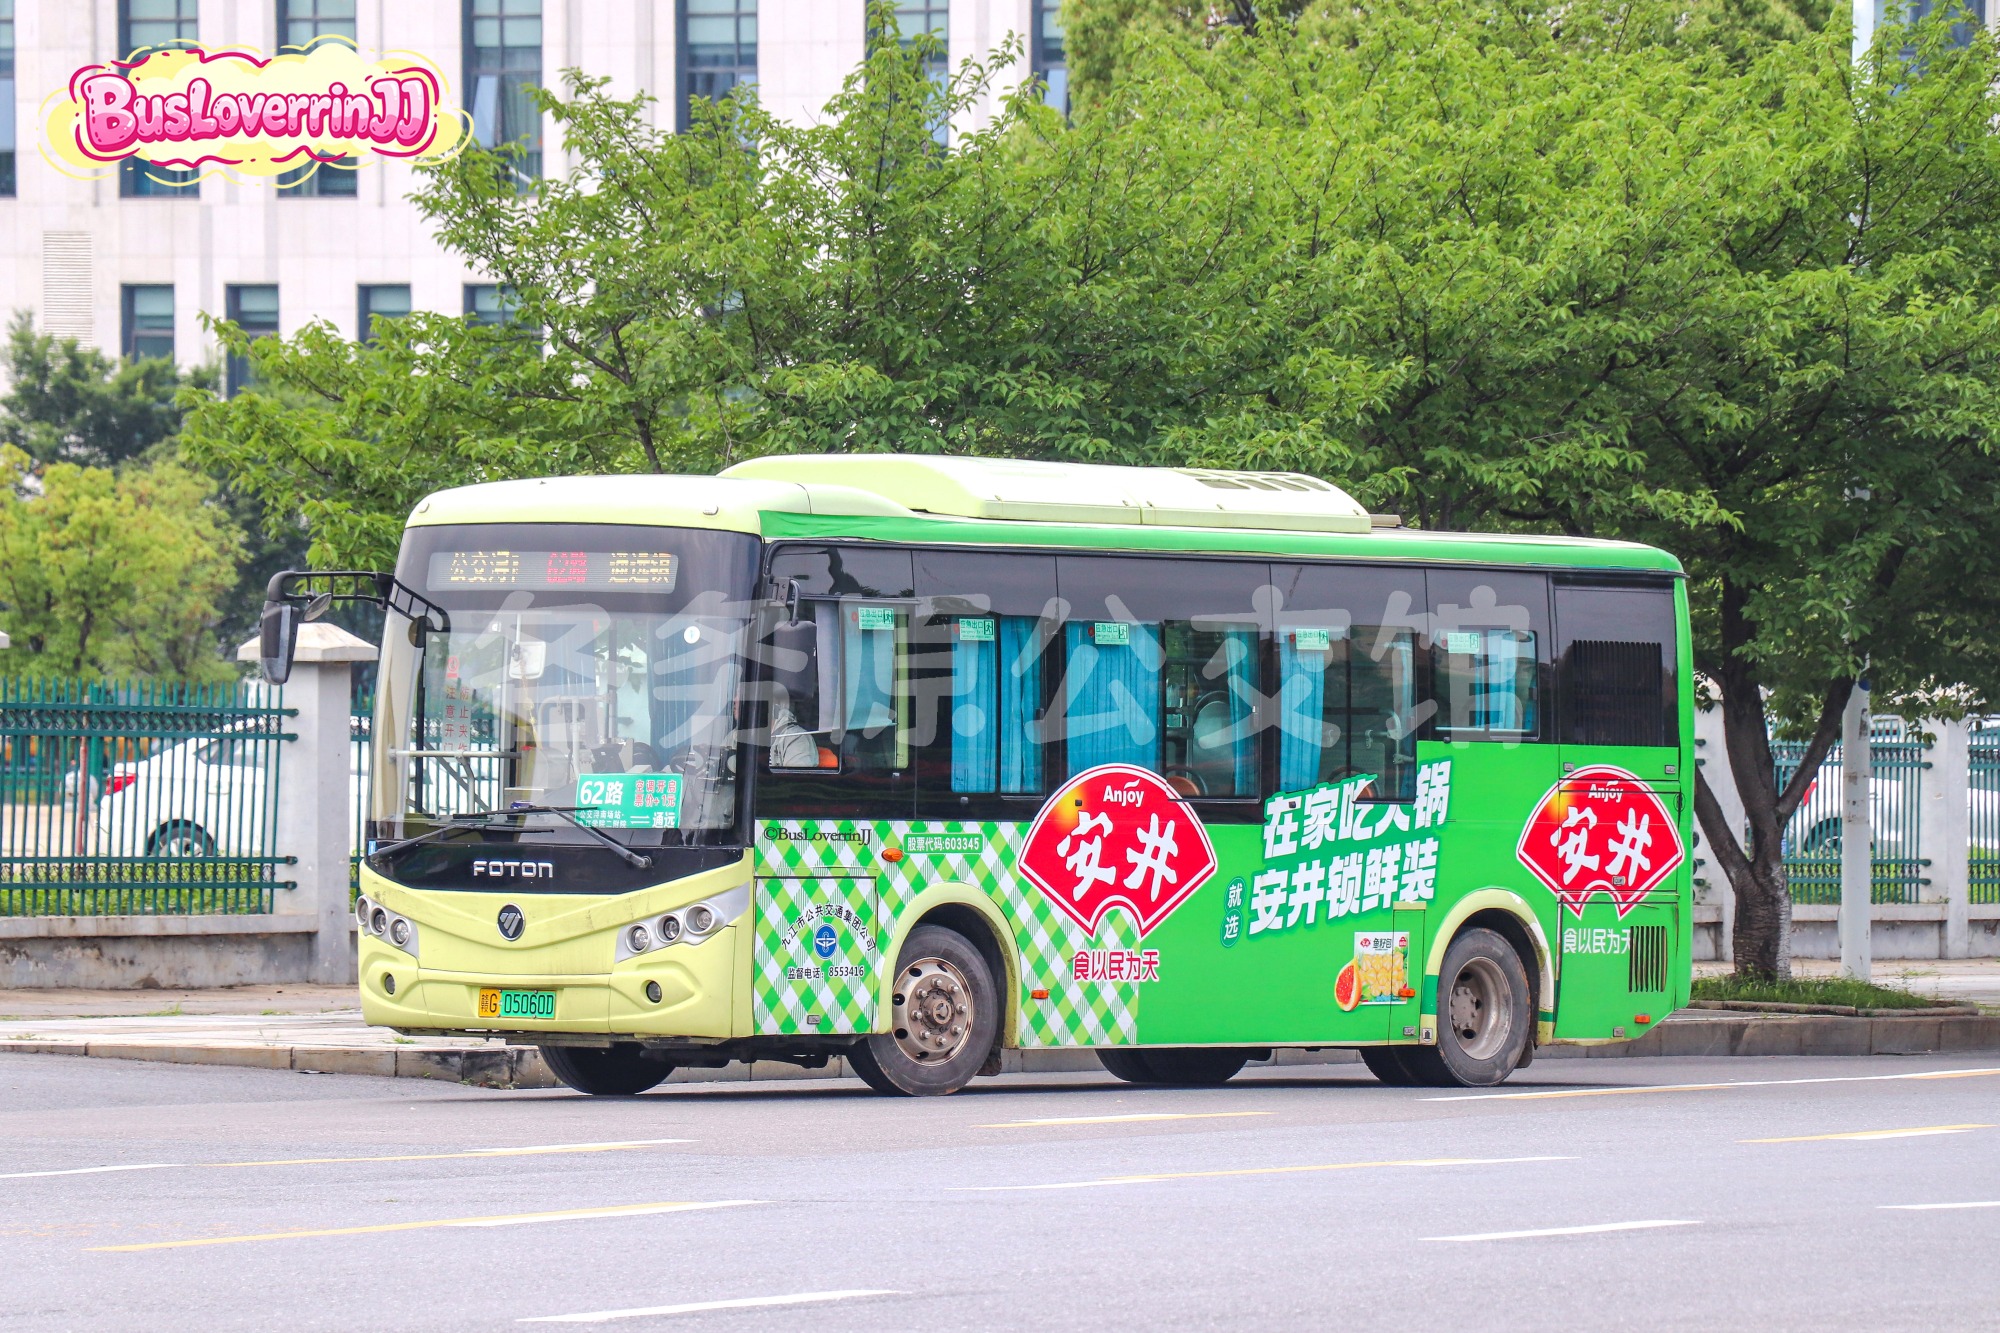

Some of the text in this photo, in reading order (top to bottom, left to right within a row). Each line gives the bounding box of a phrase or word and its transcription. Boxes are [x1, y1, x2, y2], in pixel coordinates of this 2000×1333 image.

[580, 781, 623, 805] 62路
[635, 780, 676, 793] 空调开启
[1103, 780, 1144, 807] Anjoy
[1588, 781, 1623, 802] Anjoy
[652, 812, 676, 828] 通远
[907, 836, 979, 851] 股票代码:603345
[1551, 804, 1653, 886] 安井
[1057, 811, 1178, 902] 安井
[473, 861, 554, 878] FOTON
[1249, 837, 1439, 935] 安井锁鲜装
[1224, 883, 1242, 940] 就选
[781, 903, 876, 951] 九江市公共交通集团公司
[1372, 937, 1393, 949] 鱼籽包
[828, 966, 864, 978] 8553416
[1073, 949, 1159, 982] 食以民为天
